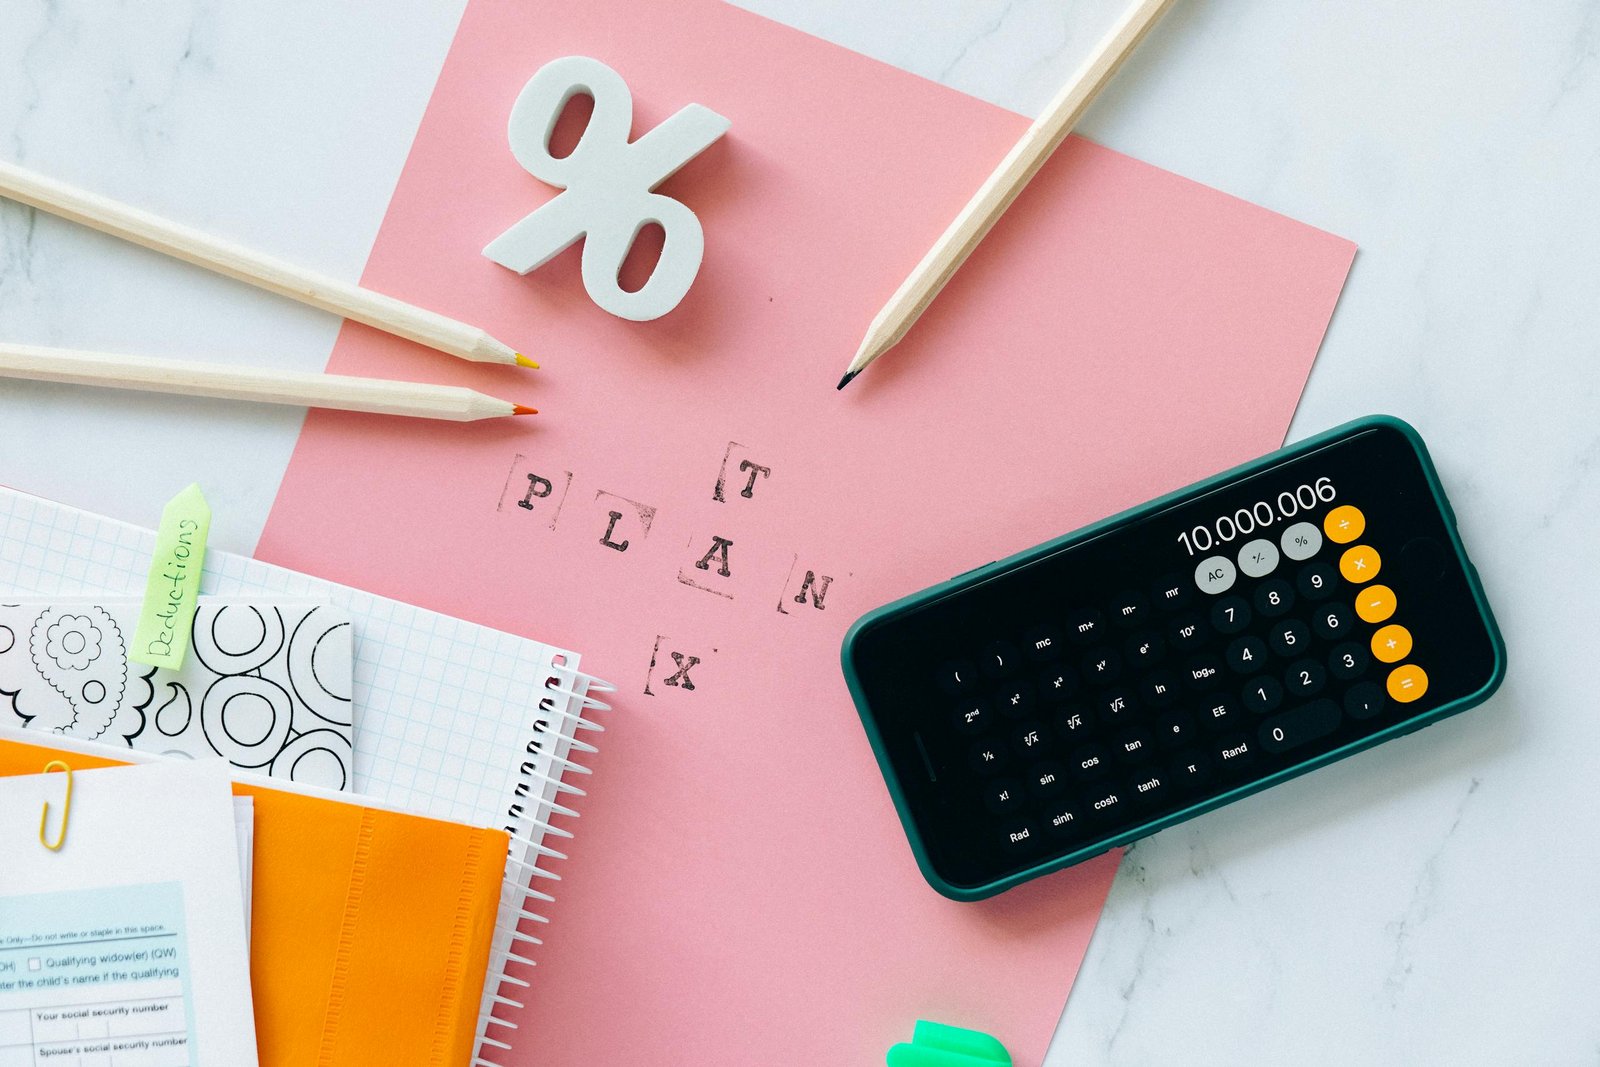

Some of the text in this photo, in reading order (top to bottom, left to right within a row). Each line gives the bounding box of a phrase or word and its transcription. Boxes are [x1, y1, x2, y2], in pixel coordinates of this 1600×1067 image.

[1177, 477, 1336, 556] 10.000.006
[146, 519, 198, 657] Deductions
[1035, 638, 1052, 650] mc
[1078, 621, 1094, 633] m+
[1165, 587, 1179, 599] mr
[1208, 568, 1225, 583] AC
[1224, 607, 1234, 623] 7
[1268, 591, 1281, 605] 8
[1311, 574, 1323, 589] 9
[1155, 684, 1166, 694] ln
[1242, 647, 1253, 661] 4
[1284, 630, 1296, 645] 5
[1327, 614, 1339, 628] 6
[999, 790, 1010, 801] x!
[1039, 774, 1055, 785] sin
[1081, 756, 1100, 769] cos
[1124, 740, 1142, 752] tan
[1172, 725, 1180, 733] e
[1212, 705, 1227, 718] EE
[1257, 687, 1267, 701] 1
[1299, 670, 1312, 686] 2
[1342, 653, 1355, 668] 3
[1009, 827, 1030, 843] Rad
[1052, 812, 1074, 826] sinh
[1094, 794, 1118, 810] cosh
[1137, 778, 1161, 793] tanh
[1221, 742, 1248, 760] Rand
[1272, 727, 1284, 742] 0
[46, 953, 97, 969] Qualifying
[100, 950, 149, 964] widow(er)
[151, 948, 177, 960] (QW)
[60, 932, 78, 940] write
[91, 928, 113, 938] staple
[124, 926, 138, 934] this
[18, 979, 34, 988] the
[72, 975, 100, 984] name
[103, 971, 109, 980] if
[112, 970, 128, 981] the
[130, 967, 180, 982] qualifying
[37, 1003, 169, 1022] Your social security number
[39, 1037, 188, 1057] Spouse's social security number
